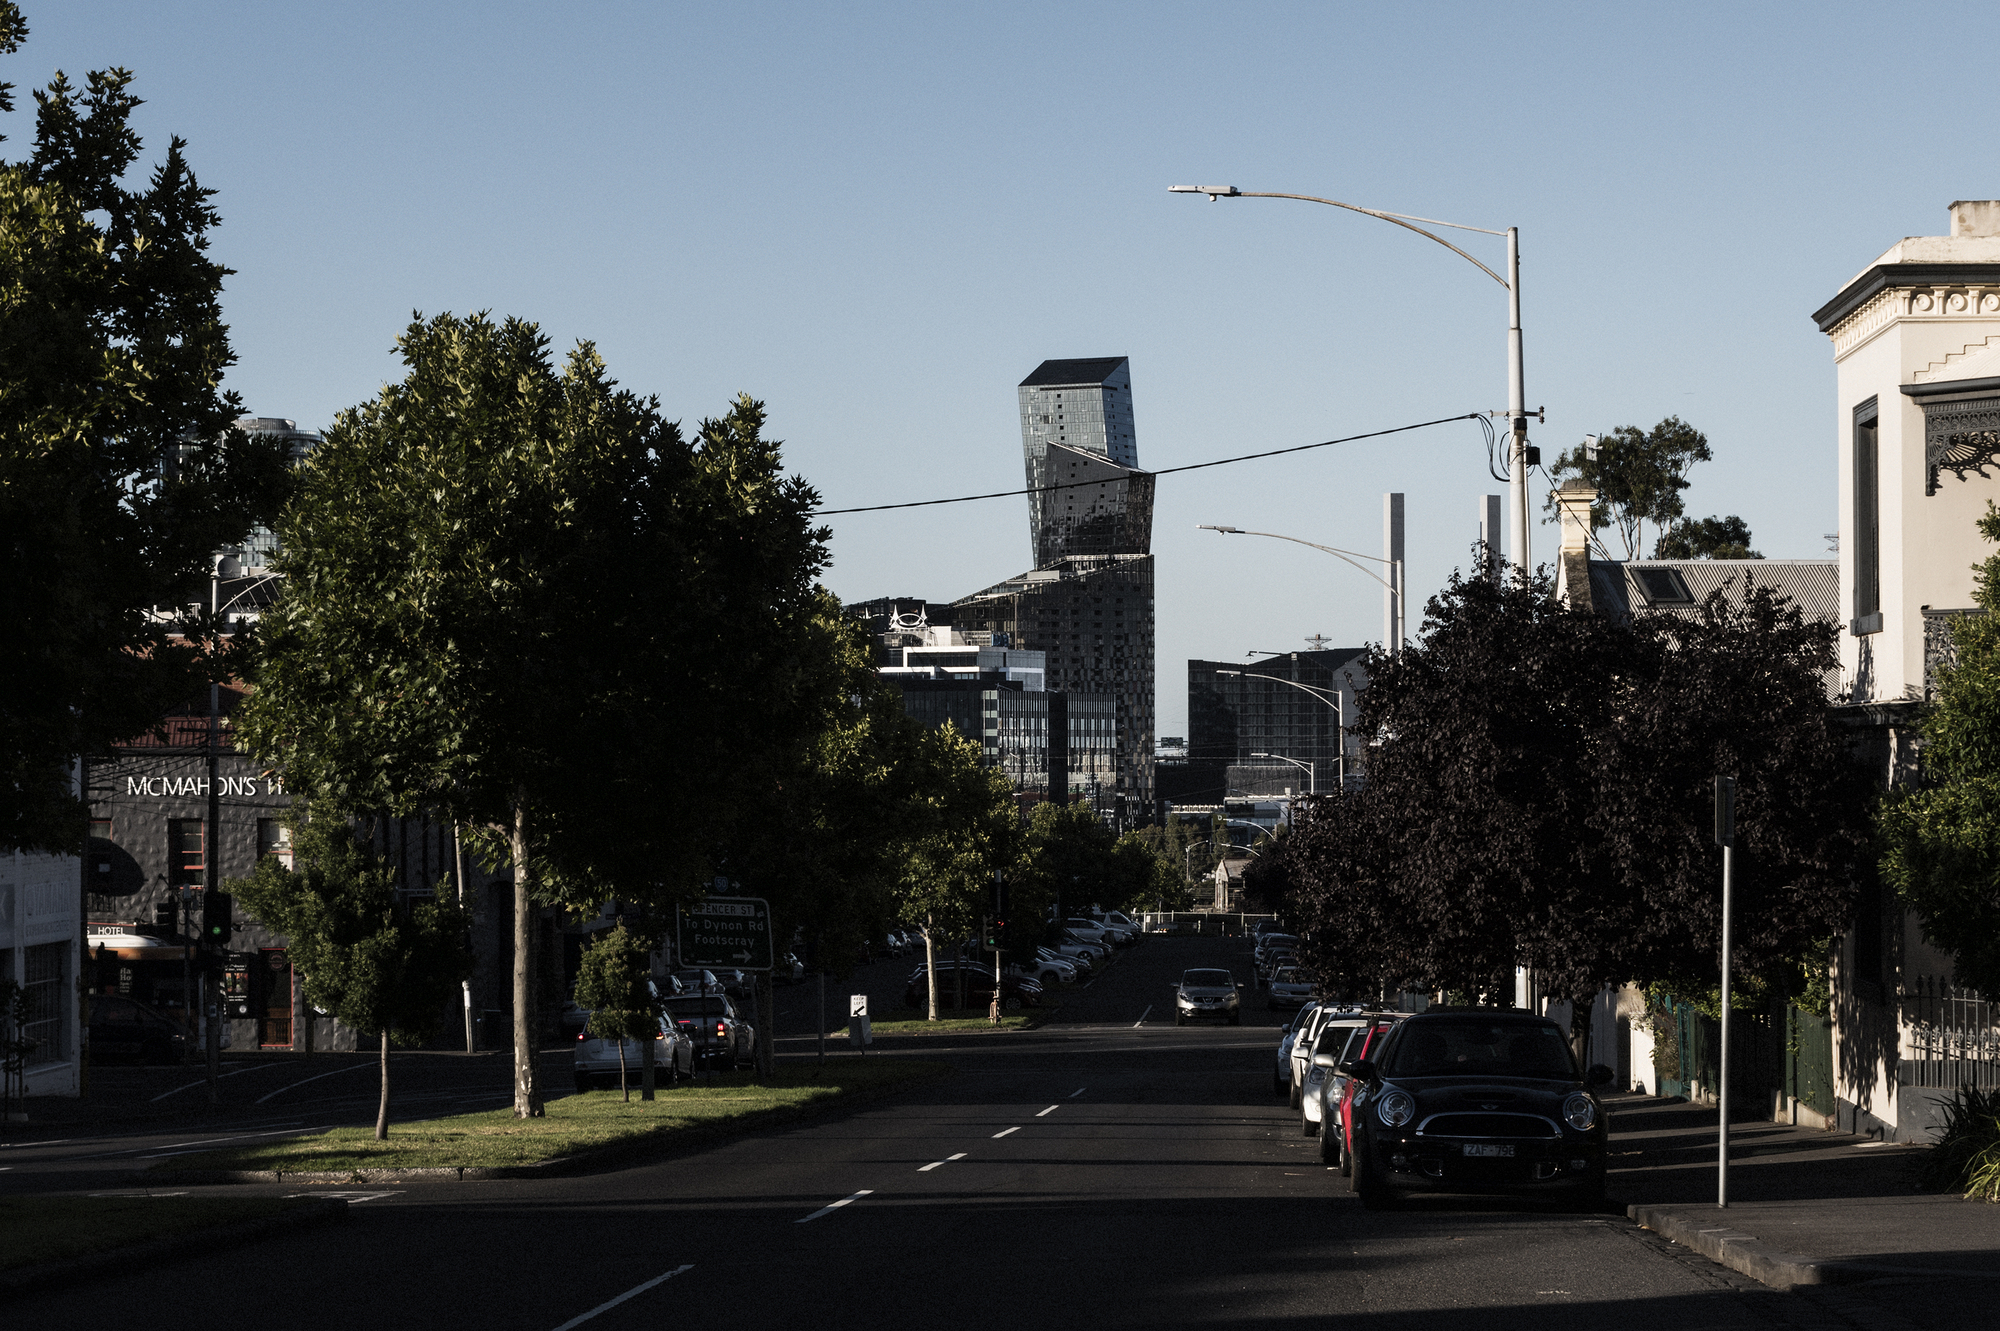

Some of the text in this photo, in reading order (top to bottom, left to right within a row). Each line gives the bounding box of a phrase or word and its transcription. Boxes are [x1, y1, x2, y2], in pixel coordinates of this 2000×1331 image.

[128, 776, 257, 796] MCMAHON'S
[717, 878, 727, 888] 50
[741, 905, 751, 915] ST
[97, 926, 124, 935] HOTEL
[684, 919, 764, 932] To Dynon Rd
[694, 933, 755, 948] Footscray
